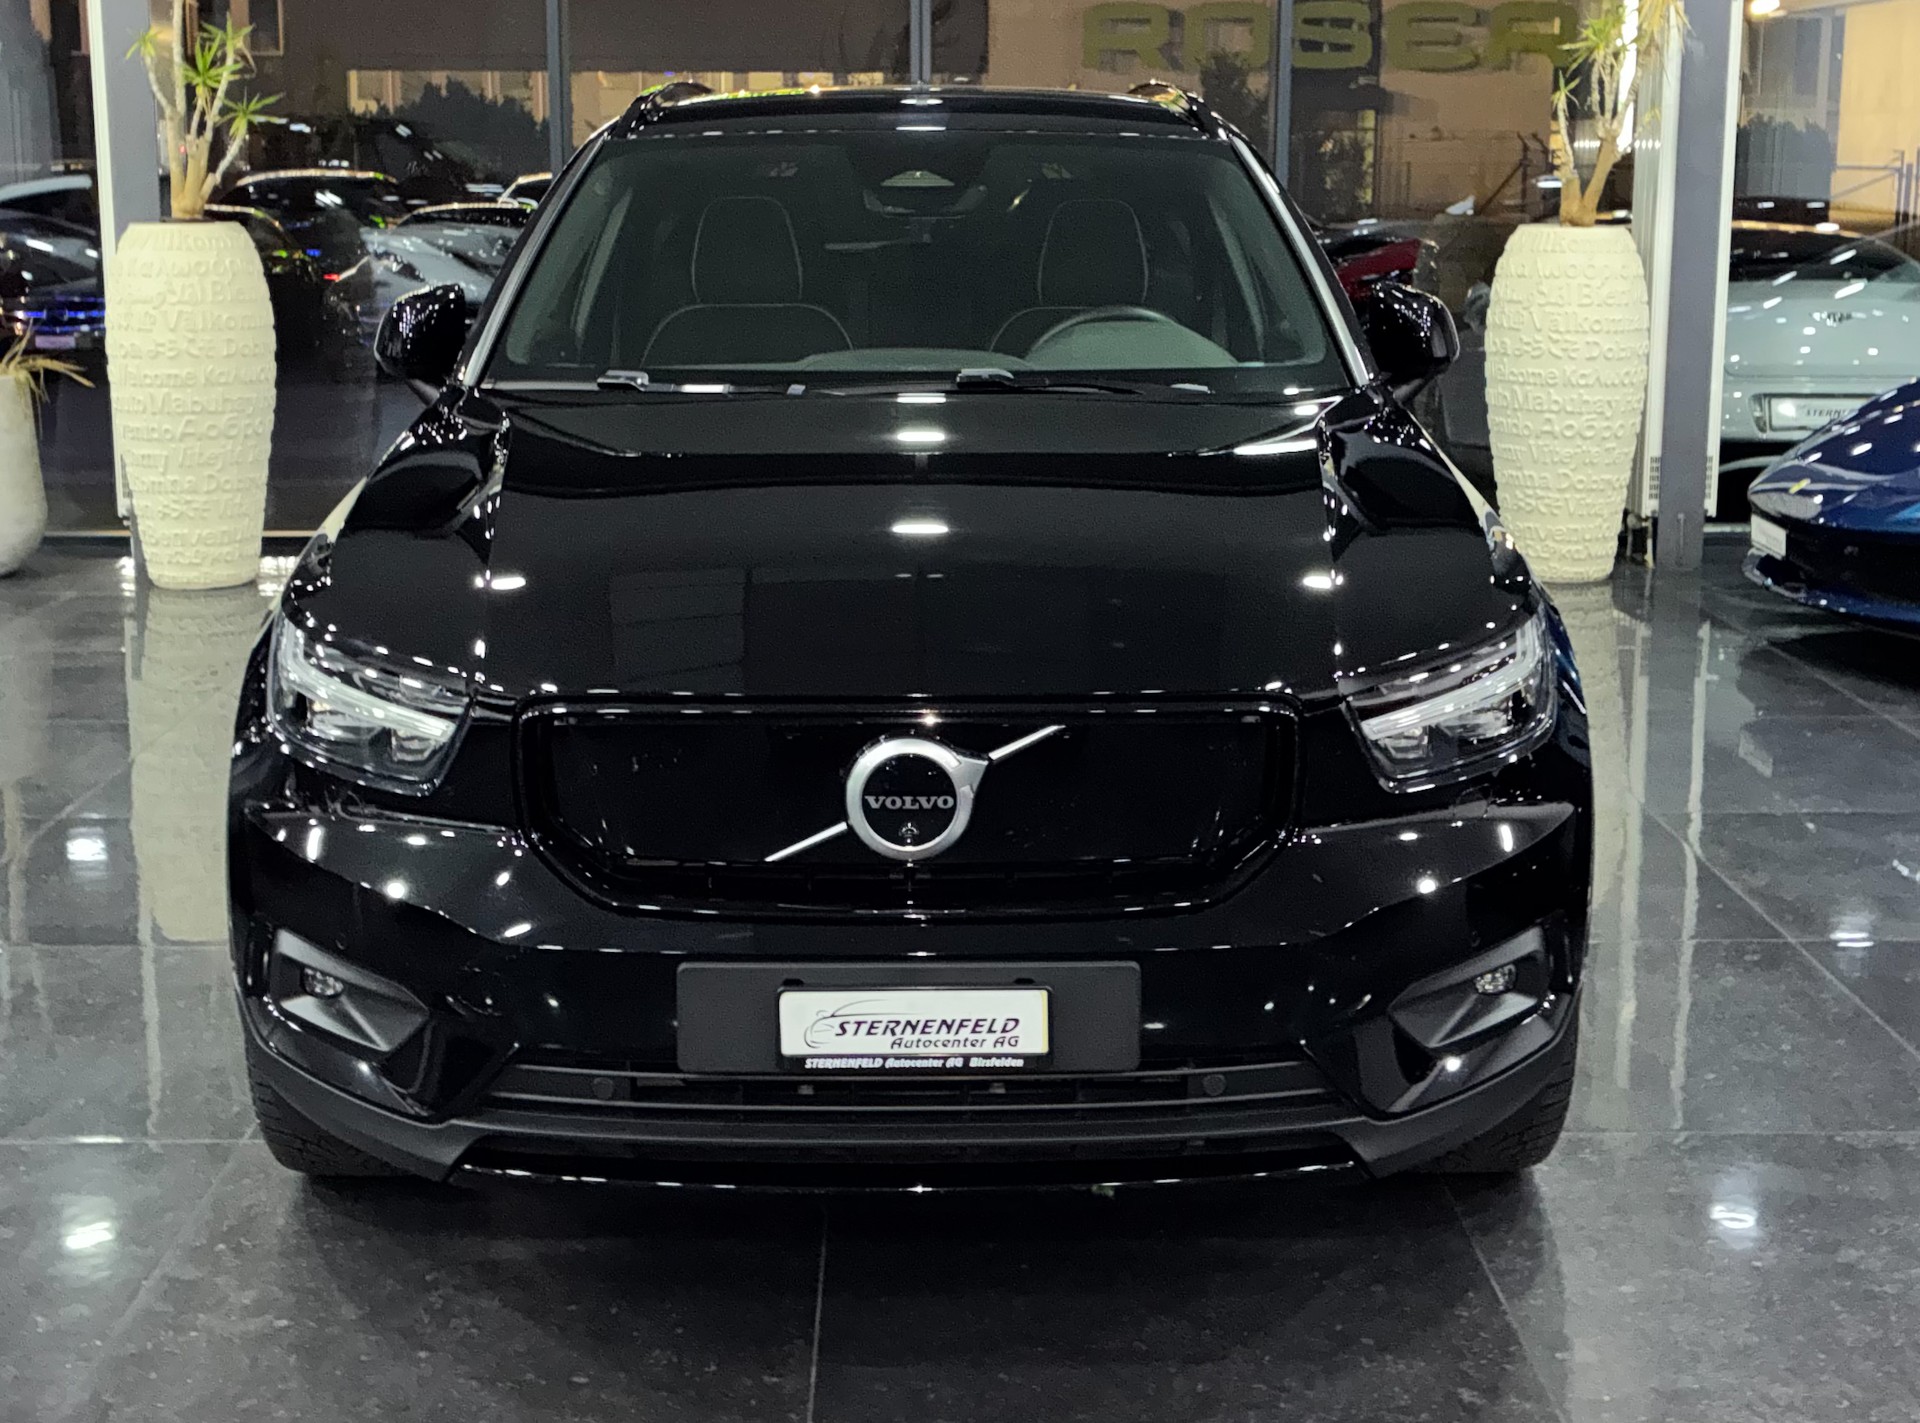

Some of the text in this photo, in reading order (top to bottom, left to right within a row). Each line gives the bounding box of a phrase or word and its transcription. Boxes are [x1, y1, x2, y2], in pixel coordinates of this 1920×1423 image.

[864, 795, 955, 809] VOLVO
[835, 1018, 1020, 1037] STERNENFELD
[890, 1036, 1020, 1050] Autocenter AG
[805, 1057, 883, 1069] STERNENFELD
[884, 1057, 944, 1068] Autocenter
[945, 1057, 963, 1068] AG
